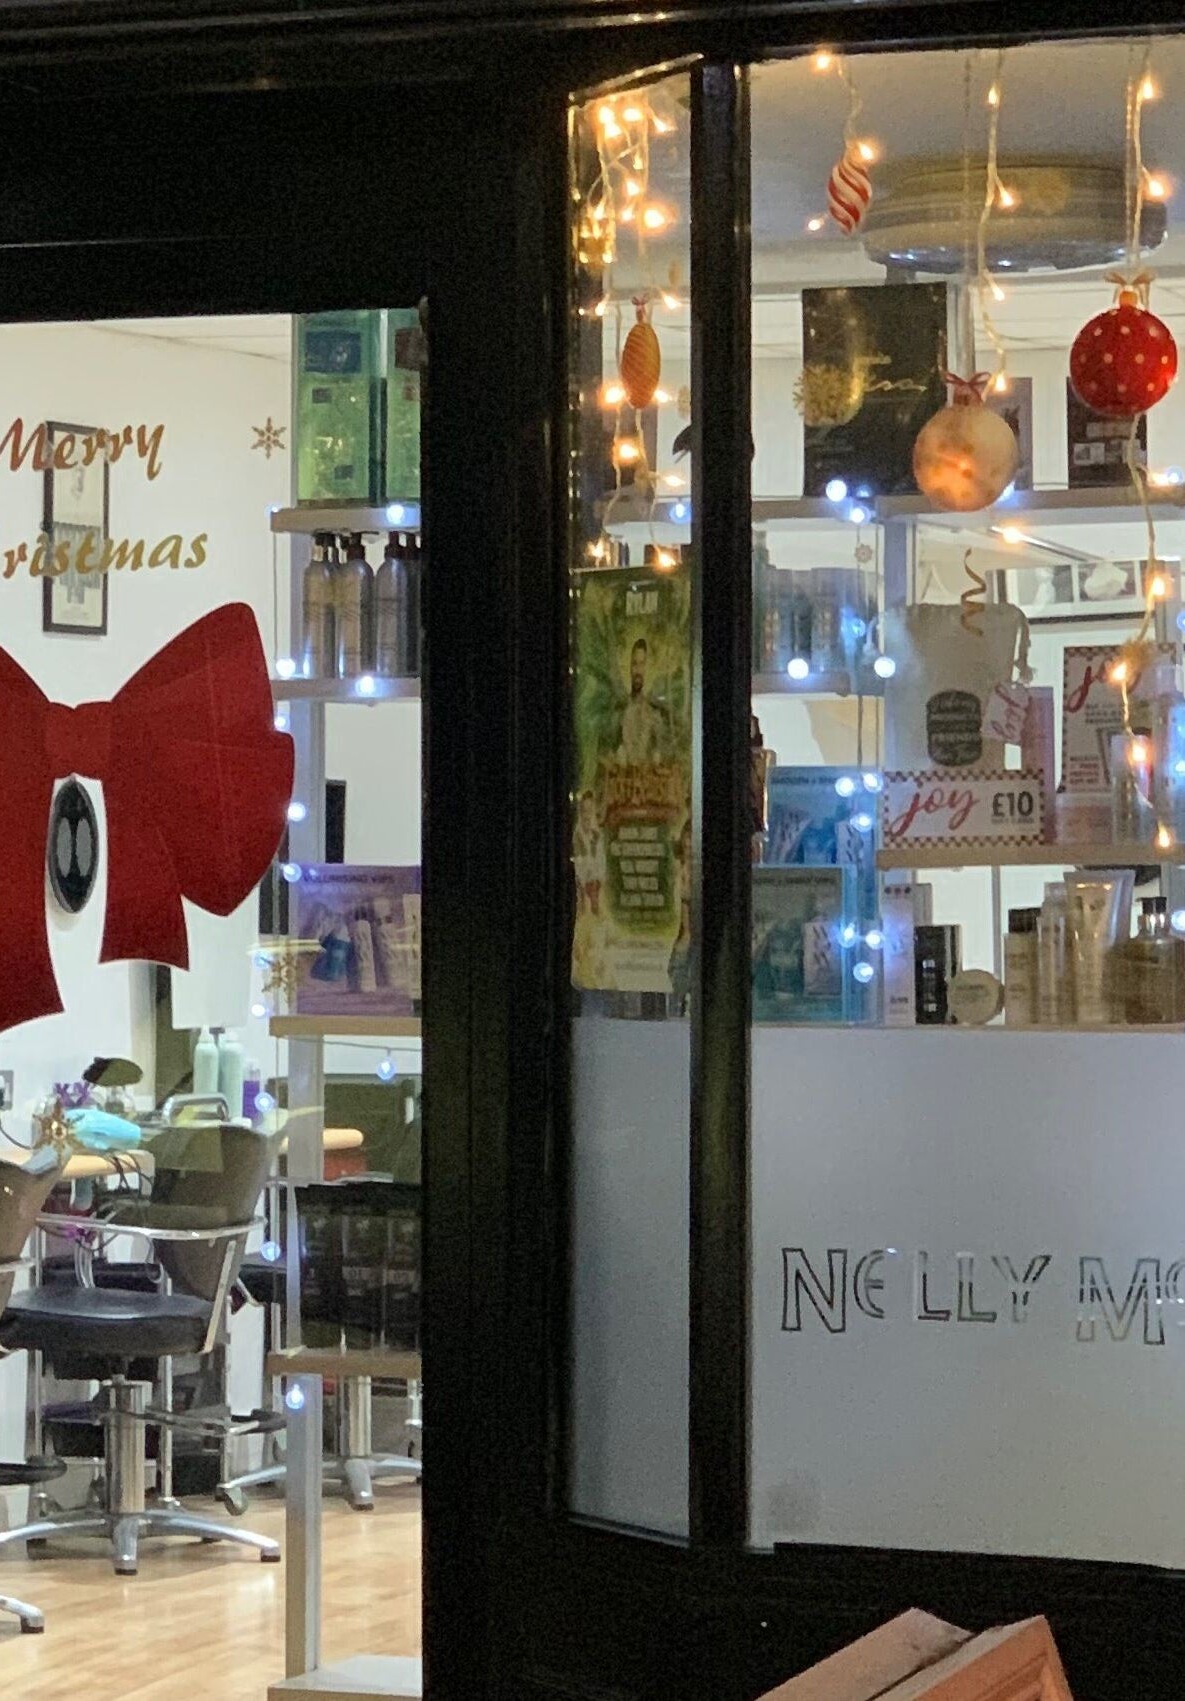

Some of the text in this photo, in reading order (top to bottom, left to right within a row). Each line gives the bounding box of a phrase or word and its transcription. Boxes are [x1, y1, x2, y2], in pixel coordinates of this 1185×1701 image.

[888, 781, 1034, 838] joy £10
[781, 1246, 1052, 1334] NELLY
